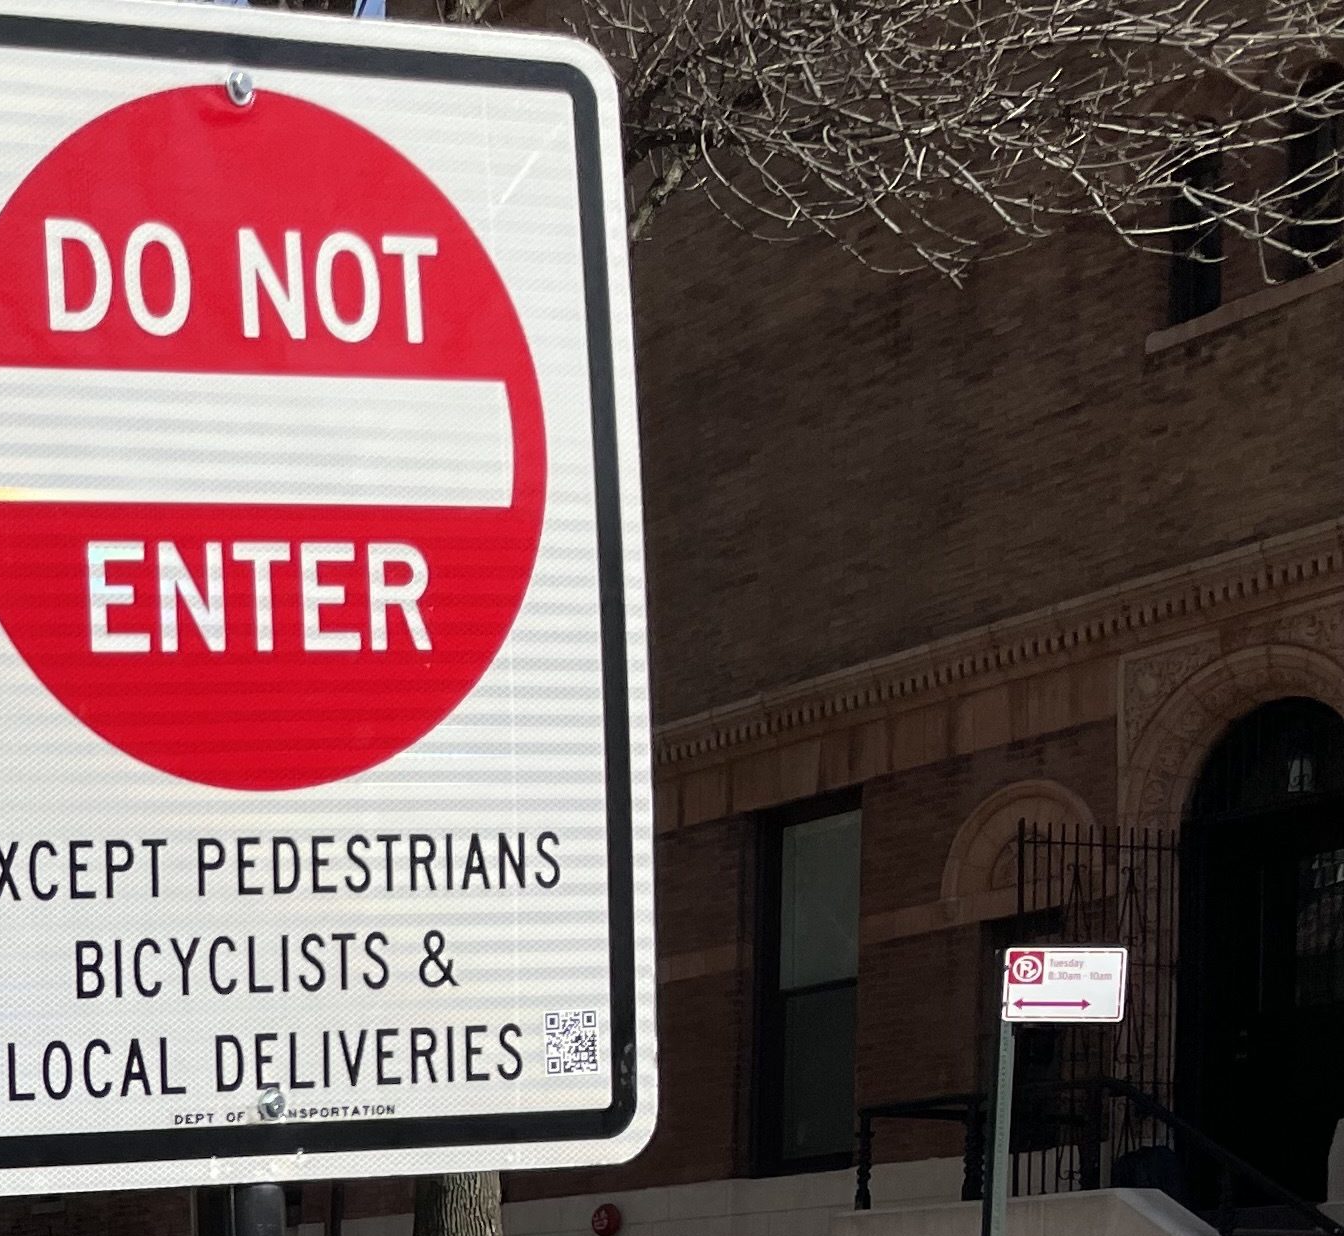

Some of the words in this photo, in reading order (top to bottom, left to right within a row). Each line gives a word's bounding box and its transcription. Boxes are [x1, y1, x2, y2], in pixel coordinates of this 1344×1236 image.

[44, 219, 192, 337] DO
[241, 227, 438, 344] NOT
[88, 541, 433, 654] ENTER
[196, 831, 562, 897] PEDESTRIANS
[75, 931, 391, 1000] BICYCLISTS
[419, 930, 459, 988] &
[1049, 958, 1084, 970] Tuesday
[8, 1038, 188, 1102] LOCAL
[215, 1023, 524, 1093] DELIVERIES
[175, 1113, 214, 1126] DEPT
[227, 1112, 246, 1123] OF
